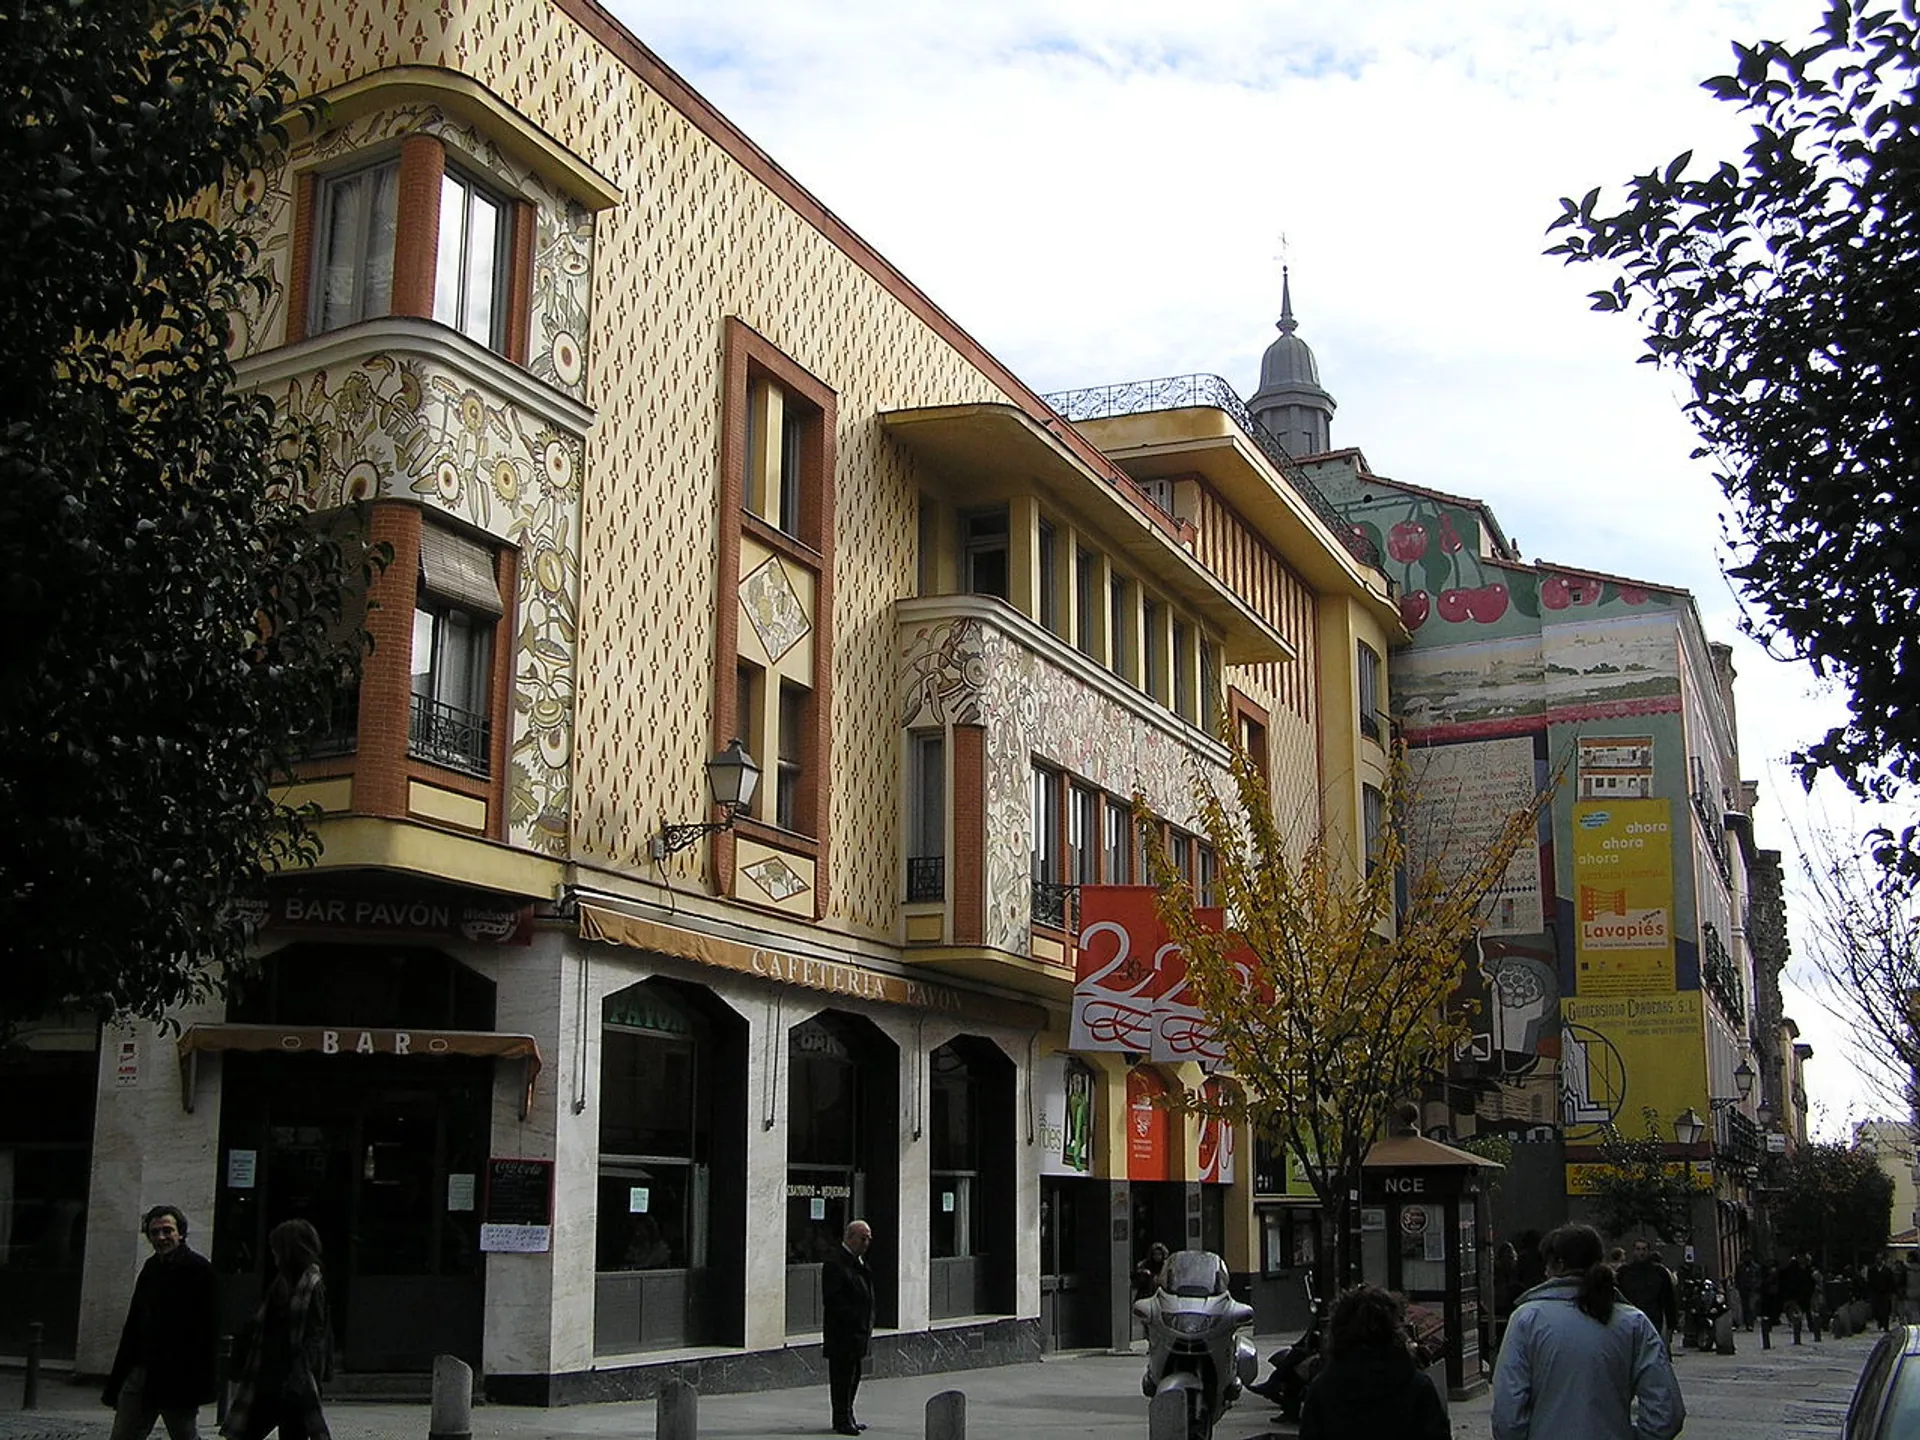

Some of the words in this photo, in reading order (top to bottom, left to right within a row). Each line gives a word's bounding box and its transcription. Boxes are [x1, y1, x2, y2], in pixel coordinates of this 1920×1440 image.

[1625, 820, 1669, 834] ahora
[1602, 836, 1644, 850] ahora
[1578, 852, 1620, 865] ahora
[285, 897, 346, 922] BAR
[355, 899, 449, 927] PAVÓN
[1583, 920, 1665, 940] Lavapiés
[323, 1030, 411, 1055] BAR
